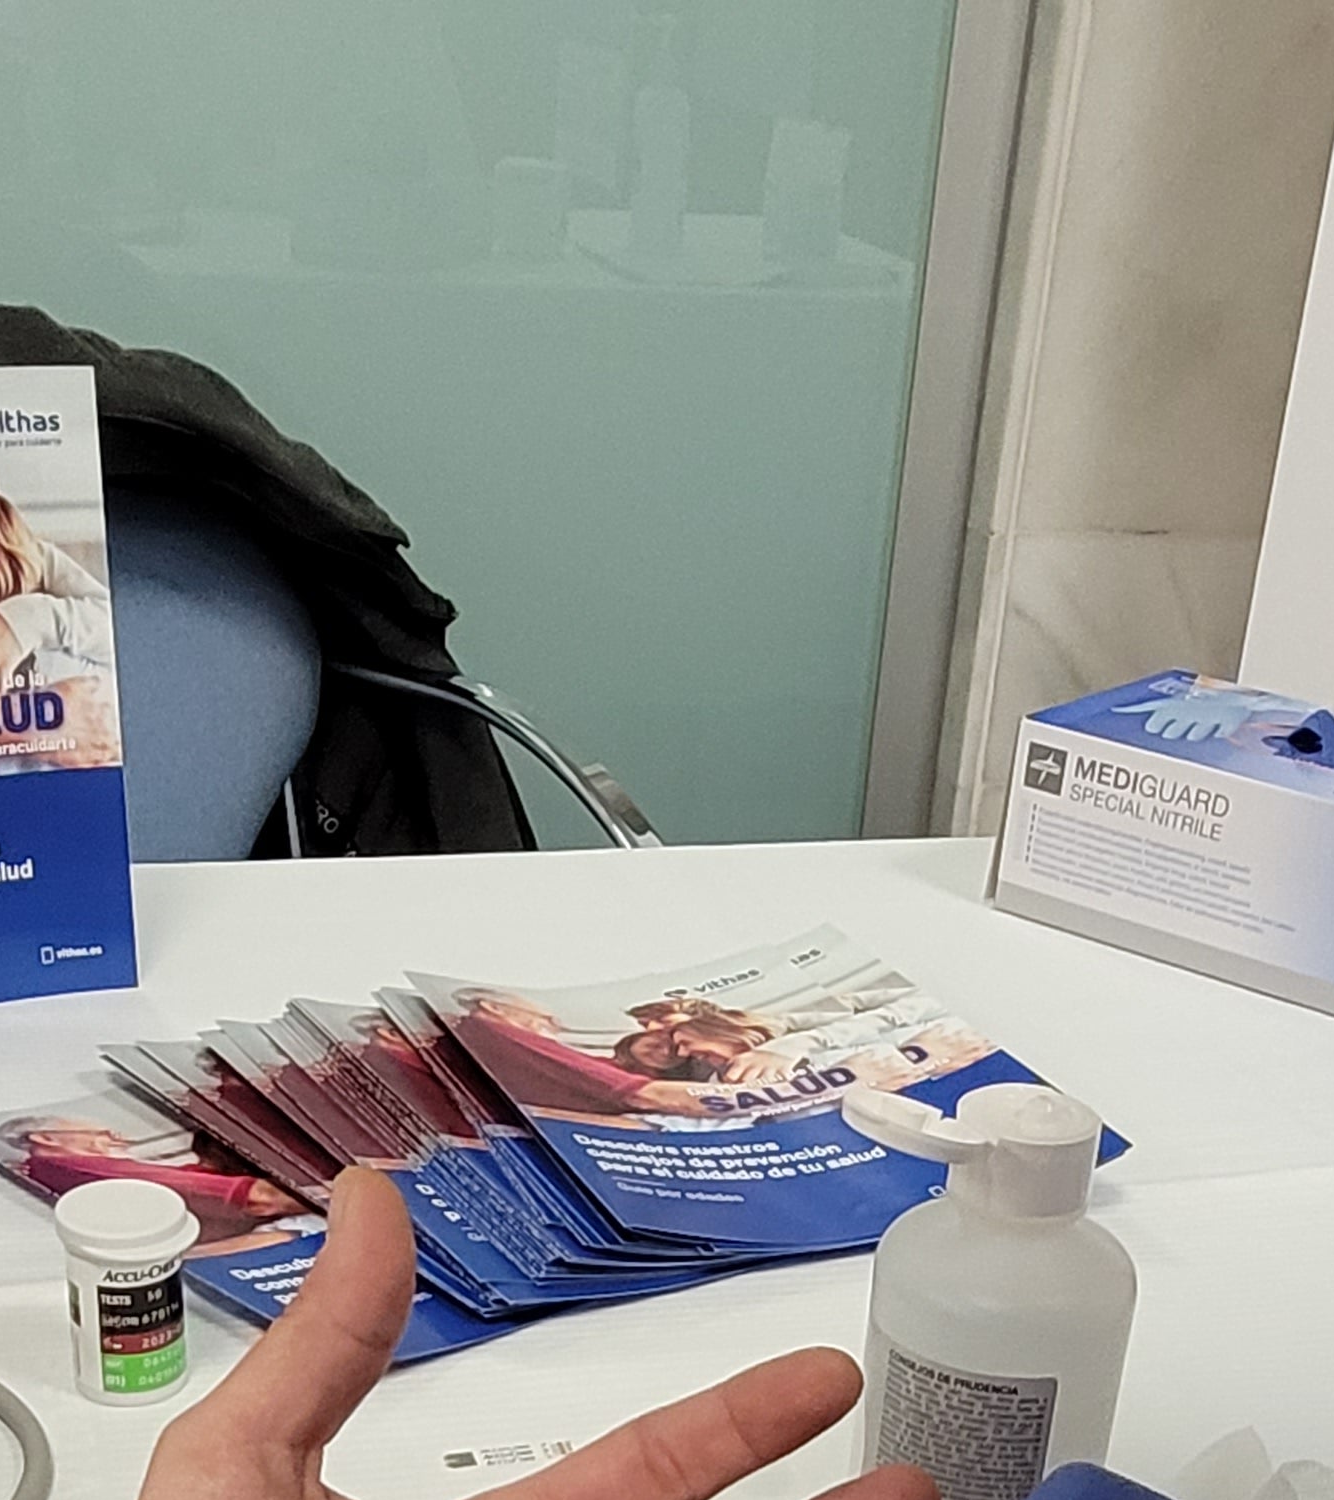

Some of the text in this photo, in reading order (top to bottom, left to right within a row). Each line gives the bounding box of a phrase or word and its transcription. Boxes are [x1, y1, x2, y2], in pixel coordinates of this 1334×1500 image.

[1074, 756, 1230, 818] MEDIGUARD
[1069, 783, 1223, 842] SPECIAL NITRILE
[694, 967, 760, 994] vithas
[699, 1066, 856, 1113] SALUD
[573, 1132, 780, 1157] Descubre nuestros
[586, 1142, 843, 1170] consejos de prevención
[597, 1159, 649, 1176] para
[675, 1167, 764, 1181] cuidado
[768, 1163, 797, 1180] de
[799, 1160, 823, 1174] tu
[826, 1145, 887, 1169] salud
[229, 1256, 317, 1280] Descub
[937, 1371, 950, 1384] DE
[953, 1377, 1019, 1396] PRUDENCIA
